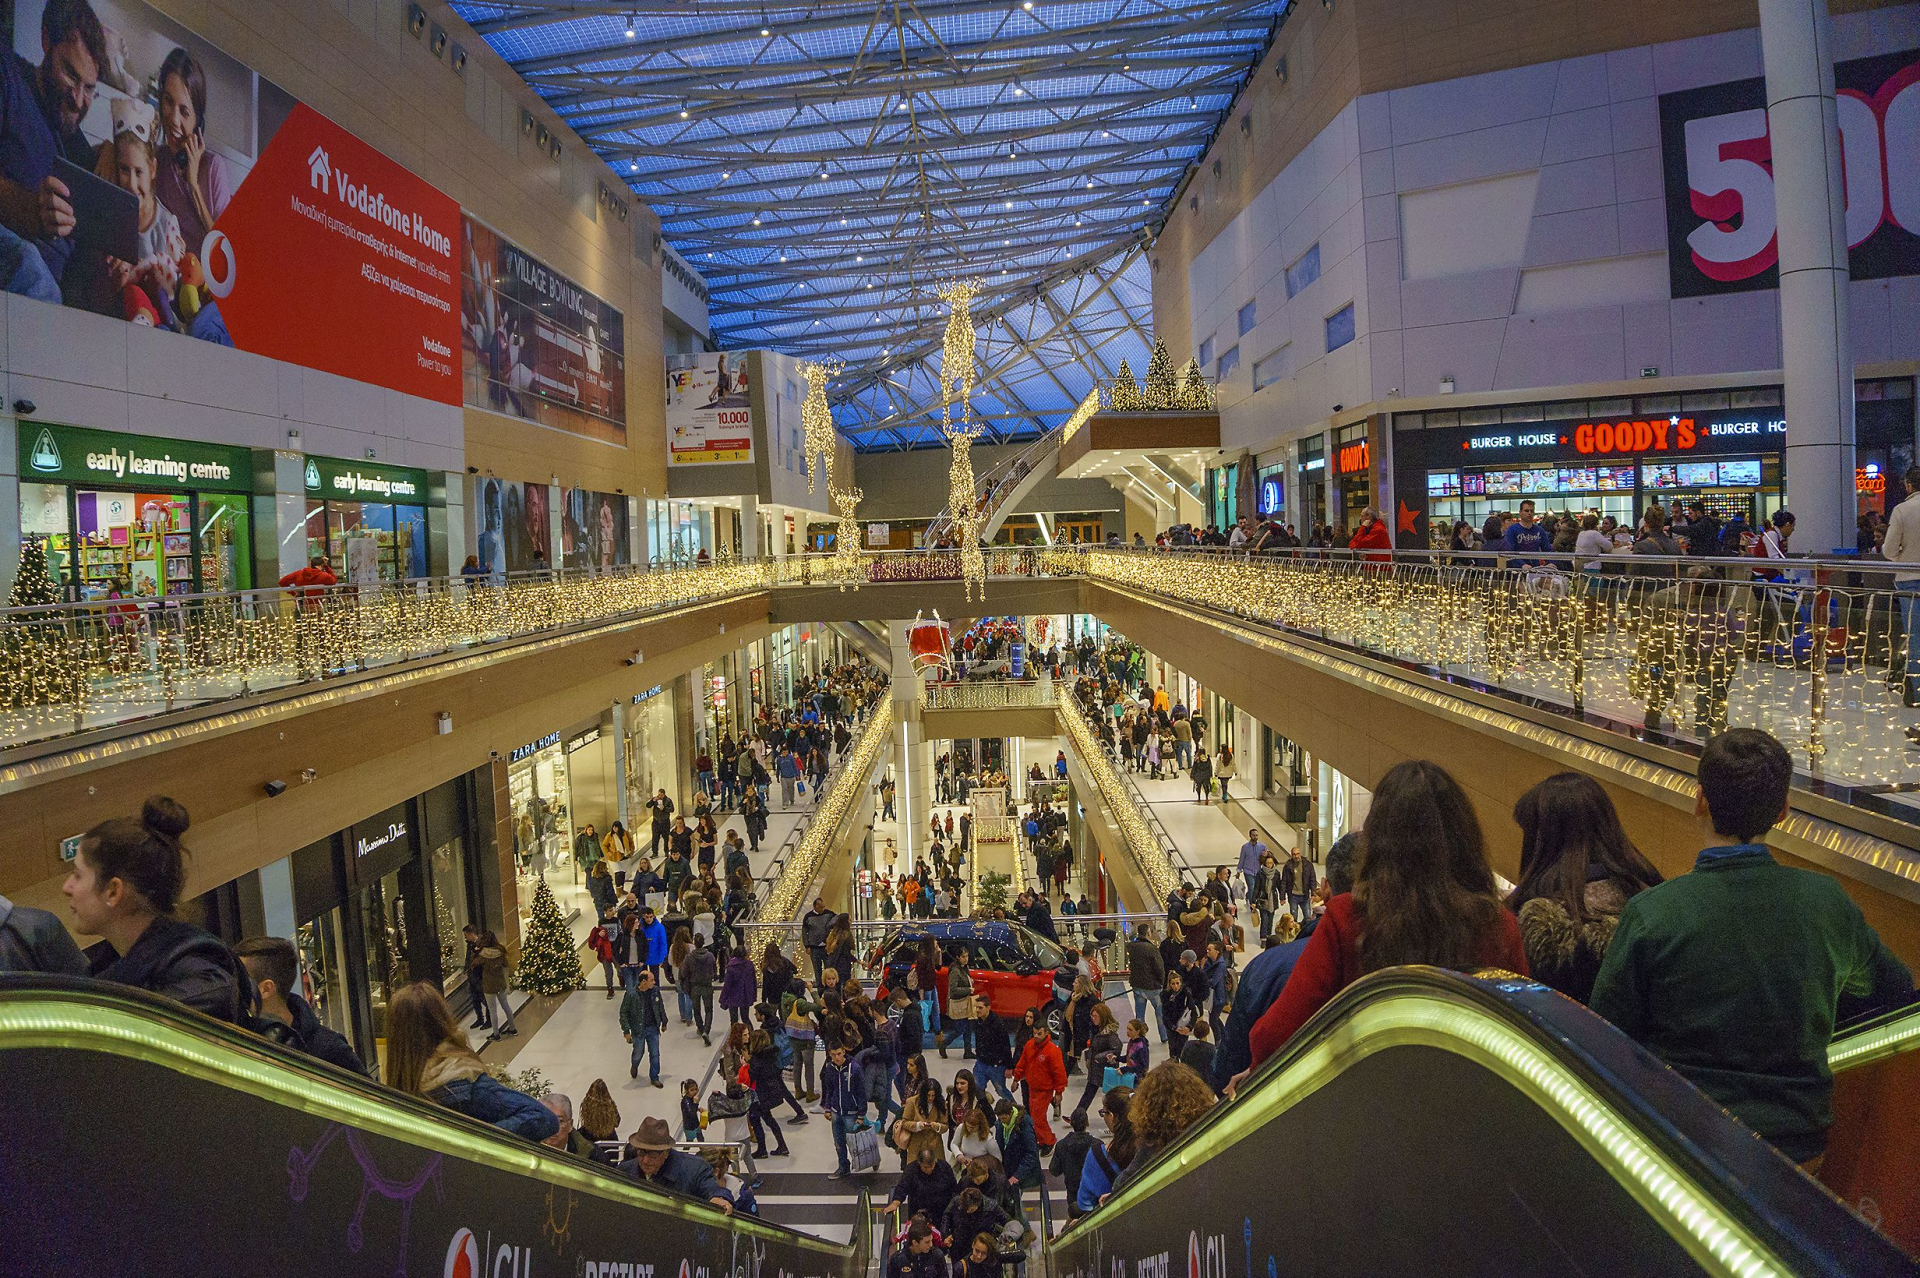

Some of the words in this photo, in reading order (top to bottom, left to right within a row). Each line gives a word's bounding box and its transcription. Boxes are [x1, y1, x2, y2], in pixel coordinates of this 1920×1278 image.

[335, 168, 410, 236] Vodafone
[413, 212, 450, 257] Home
[291, 195, 327, 229] Μοναδική
[357, 231, 388, 258] σταθερής
[388, 244, 394, 256] &
[394, 245, 416, 268] Internet
[361, 263, 380, 284] Αξίζει
[381, 273, 390, 287] να
[416, 289, 451, 313] περισσότερο
[514, 252, 546, 294] VILLAGE
[549, 276, 583, 316] BOWLING
[422, 336, 451, 357] Vodafone
[417, 353, 434, 370] Power
[434, 360, 441, 372] to
[441, 363, 451, 376] you
[671, 371, 692, 387] YES
[717, 411, 749, 424] 10.000
[1711, 422, 1759, 435] BURGER
[1471, 436, 1512, 449] BURGER
[1518, 433, 1556, 446] HOUSE
[1574, 418, 1697, 454] GOODY'S
[86, 448, 126, 478] early
[129, 450, 187, 482] learning
[189, 461, 230, 480] centre
[333, 472, 357, 494] early
[357, 473, 390, 496] learning
[391, 480, 415, 495] centre
[633, 691, 647, 704] ZARA
[648, 685, 662, 697] HOME
[512, 742, 536, 761] ZARA
[539, 730, 561, 749] HOME
[568, 736, 585, 752] ZARA
[584, 729, 600, 744] HOME
[358, 834, 389, 858] Massimo
[388, 823, 407, 842] Dutti
